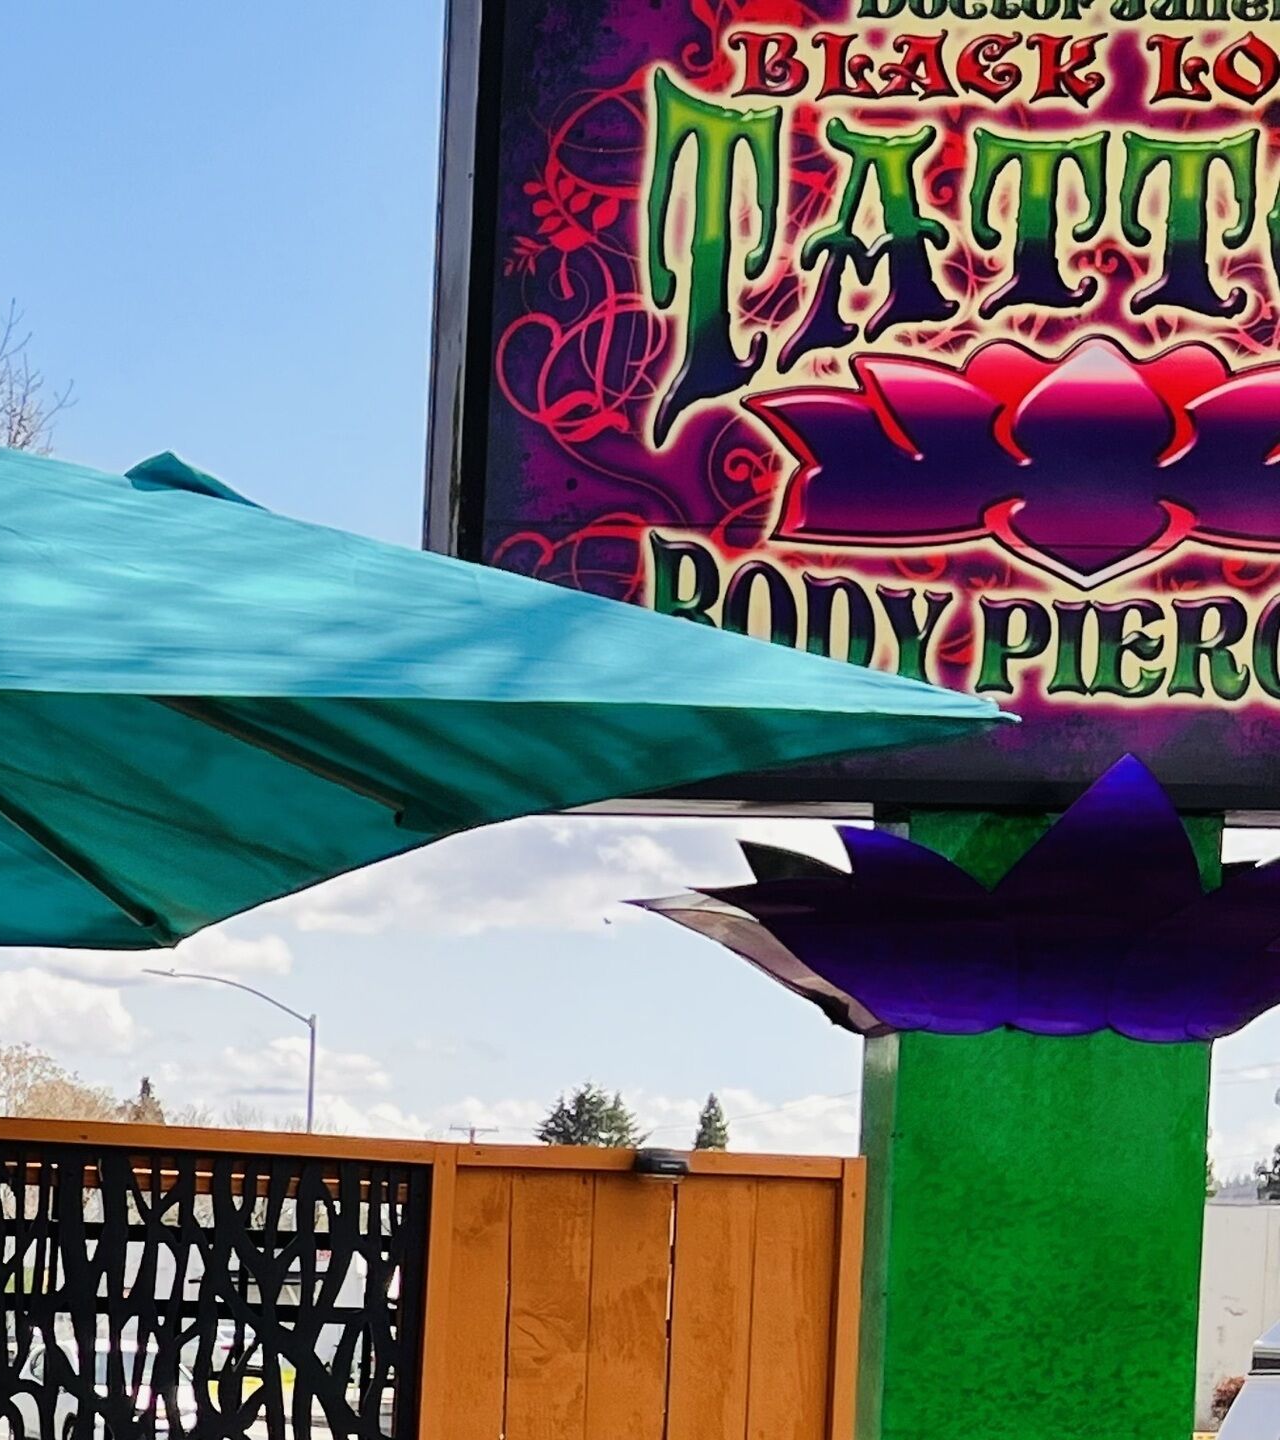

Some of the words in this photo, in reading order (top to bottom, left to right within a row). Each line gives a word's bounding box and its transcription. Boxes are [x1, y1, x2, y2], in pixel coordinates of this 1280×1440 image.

[729, 30, 1108, 108] BLACK
[648, 67, 1280, 448] TATT
[651, 530, 953, 684] BODY
